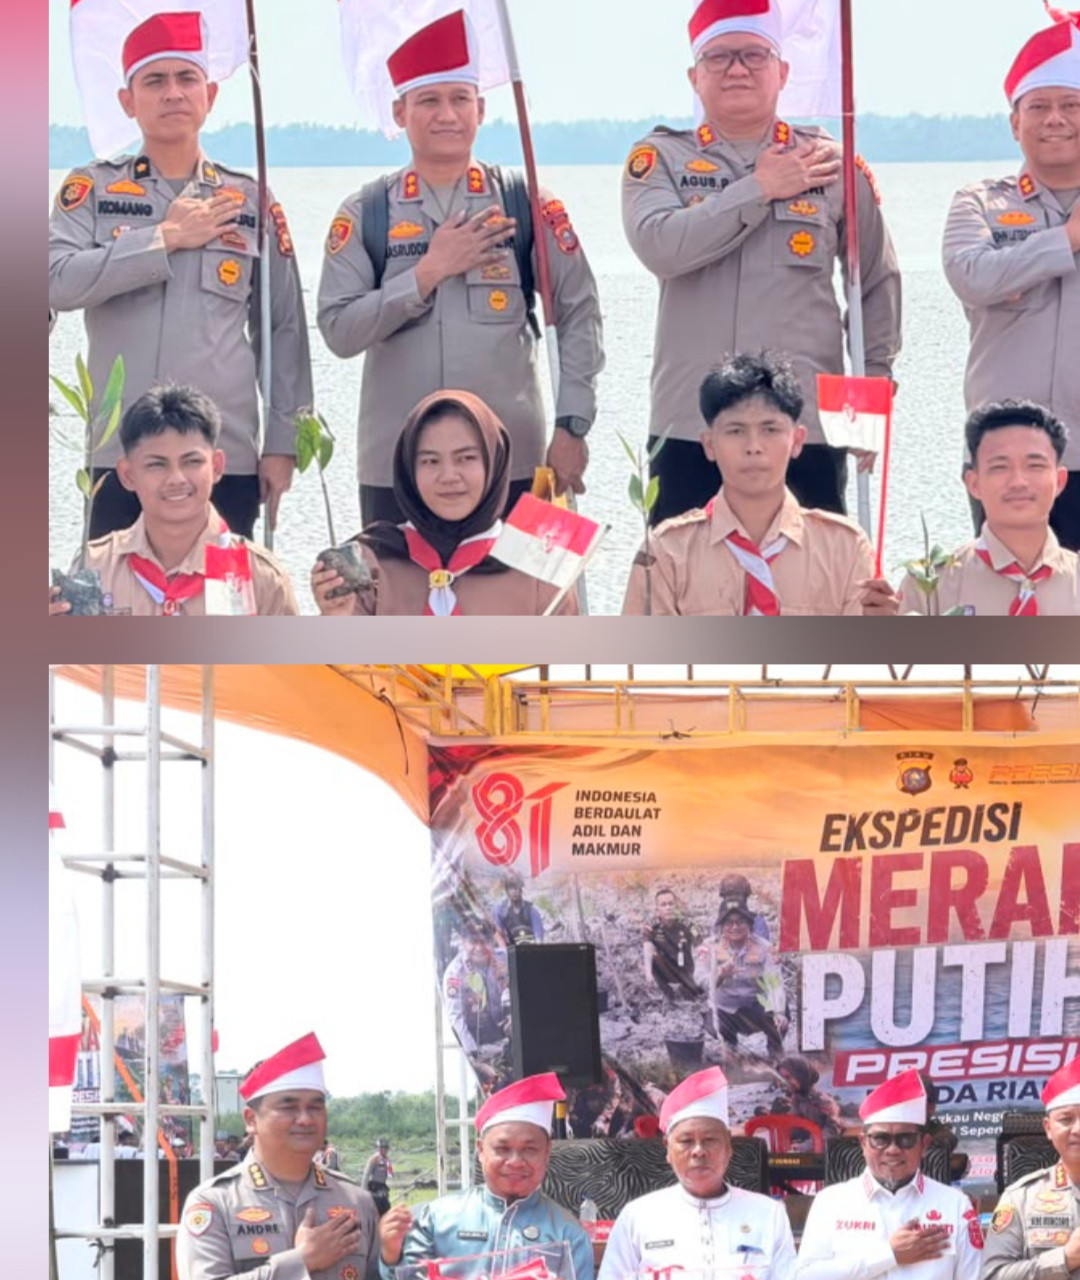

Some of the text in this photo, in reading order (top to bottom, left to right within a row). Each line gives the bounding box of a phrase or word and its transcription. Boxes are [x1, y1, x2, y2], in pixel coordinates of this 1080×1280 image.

[575, 790, 657, 803] INDONESIA
[574, 807, 661, 820] BERDAULAT
[472, 771, 571, 879] 81
[572, 825, 642, 837] ADIL DAN
[819, 802, 1022, 852] EKSPEDISI
[572, 843, 641, 856] MAKMUR
[237, 1223, 279, 1236] ANDRE
[836, 1220, 875, 1231] ZUKRI
